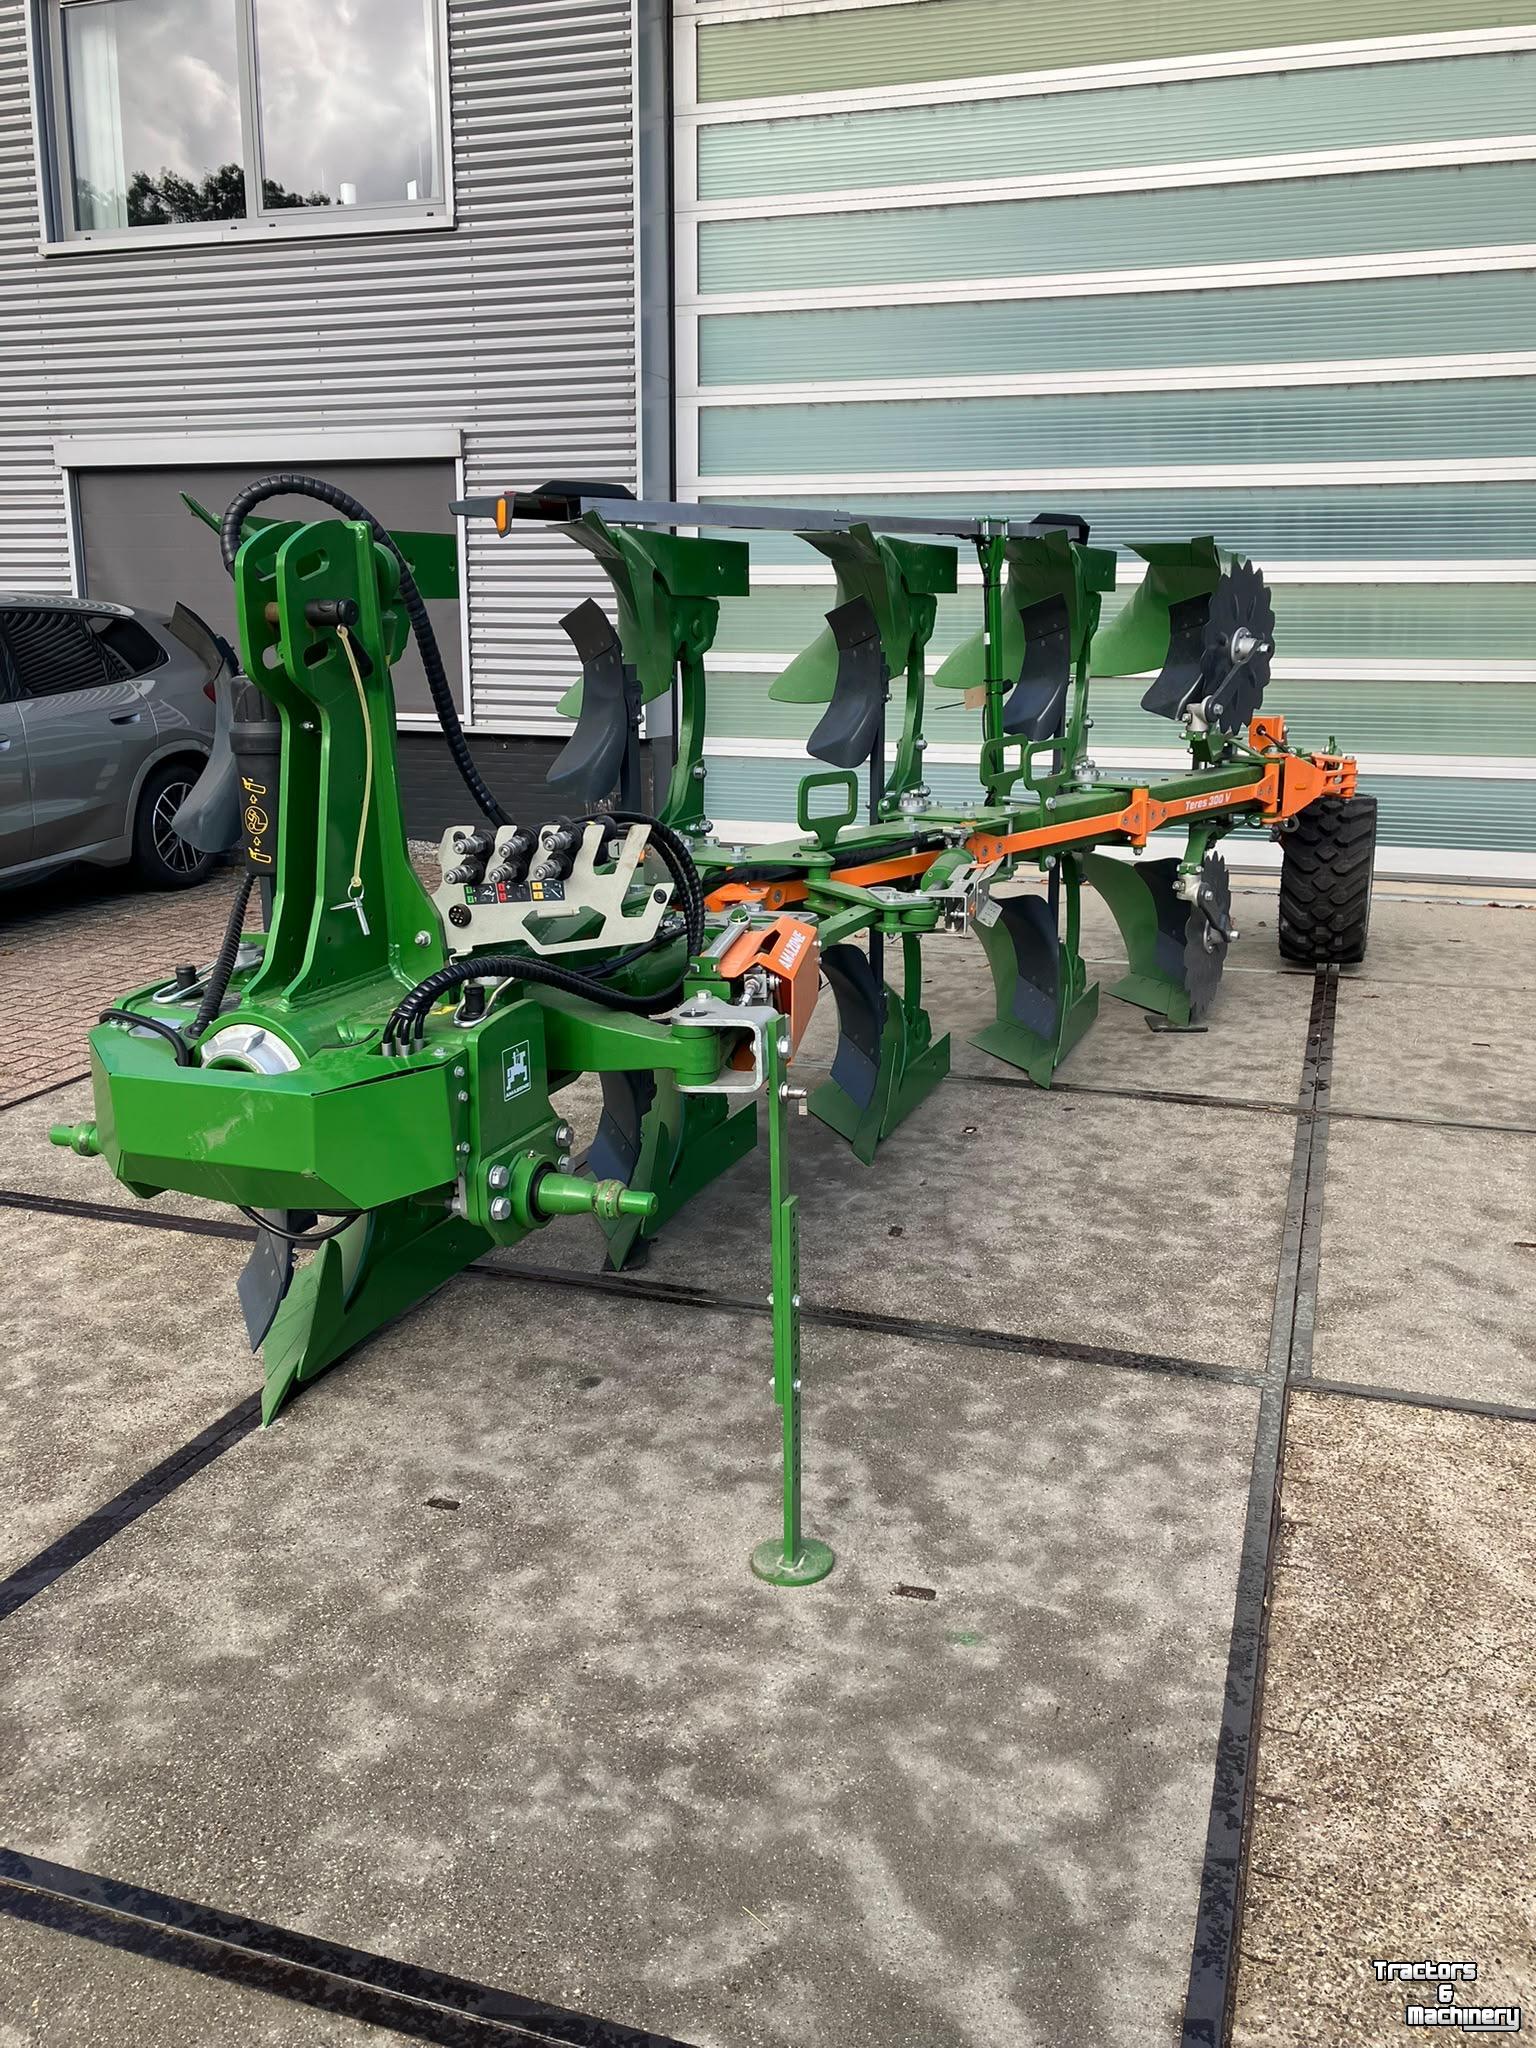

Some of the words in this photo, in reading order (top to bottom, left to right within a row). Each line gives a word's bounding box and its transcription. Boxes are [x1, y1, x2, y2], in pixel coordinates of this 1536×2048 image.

[1185, 799, 1208, 811] Teres
[1208, 794, 1224, 806] 300
[1225, 791, 1232, 803] V
[779, 929, 807, 970] AMAZONE
